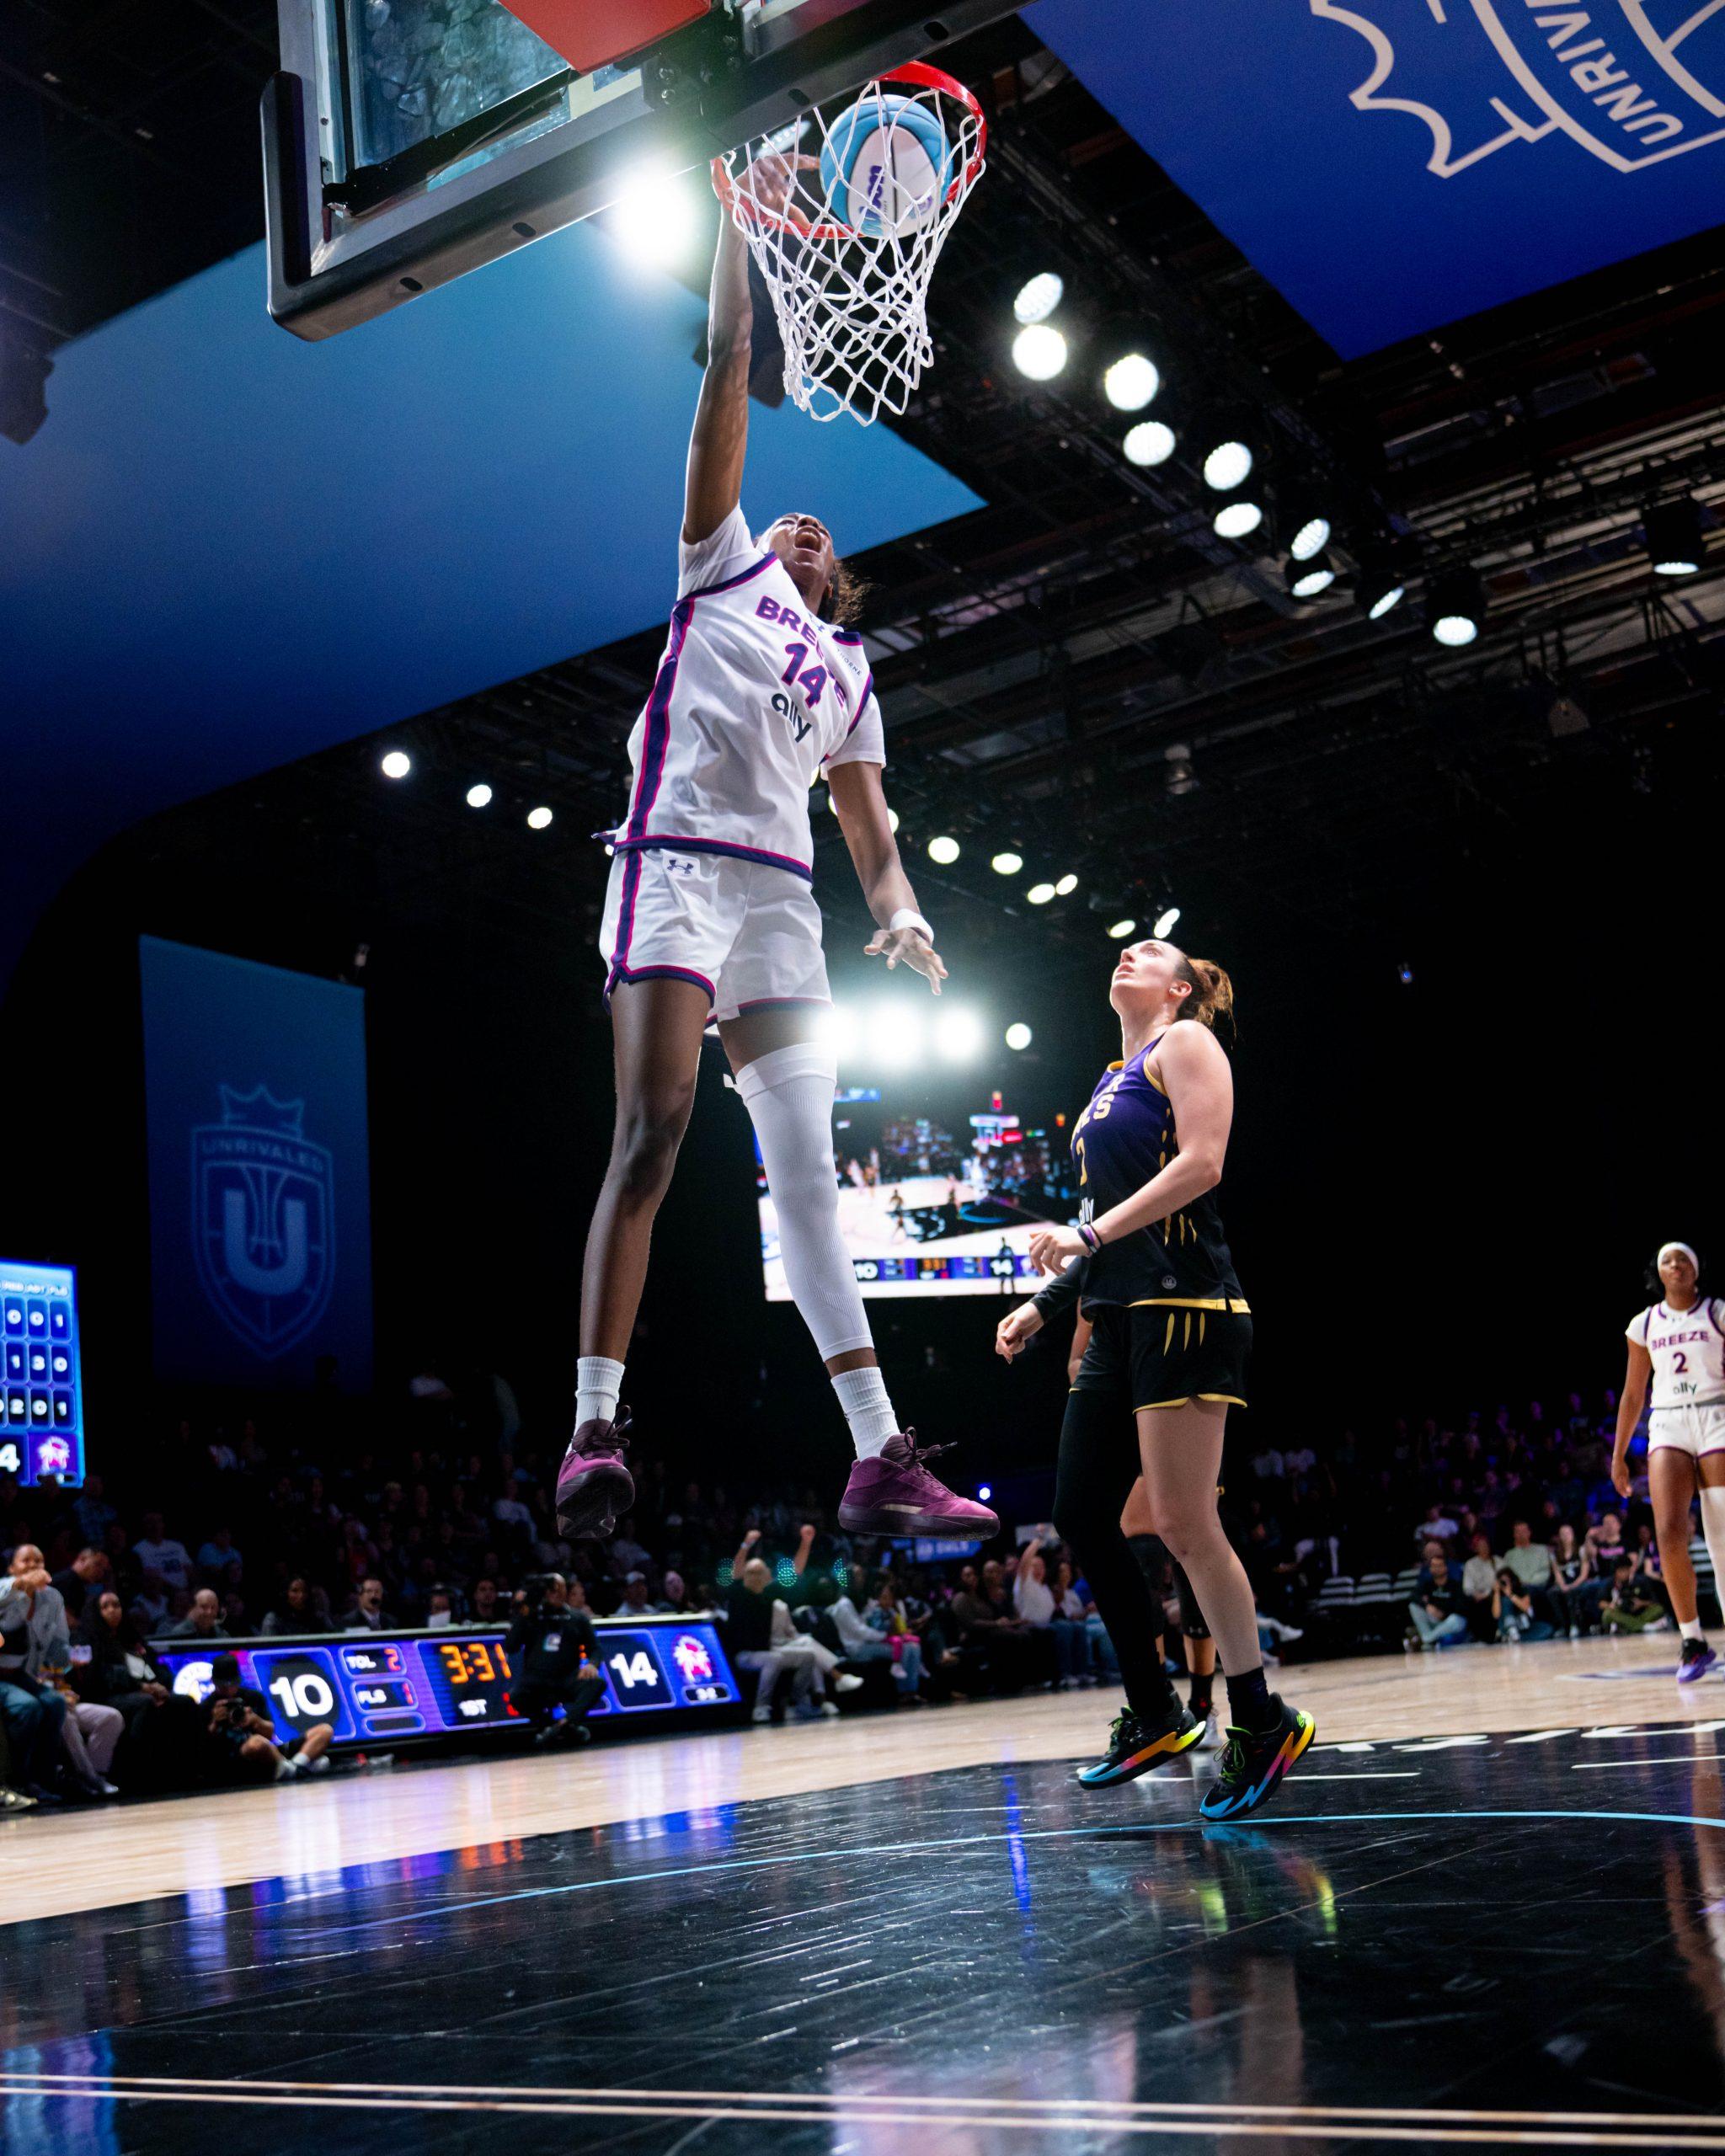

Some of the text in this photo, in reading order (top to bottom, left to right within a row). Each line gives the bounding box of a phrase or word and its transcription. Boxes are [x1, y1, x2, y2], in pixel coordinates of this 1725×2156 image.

[1525, 0, 1684, 145] UNRIV
[781, 641, 829, 710] 14
[771, 692, 813, 743] ally
[7, 1309, 22, 1325] 0
[29, 1310, 45, 1326] 0
[1652, 1330, 1710, 1351] BREEZE
[53, 1356, 68, 1373] 0
[1673, 1351, 1689, 1374] 2
[1673, 1381, 1697, 1396] ally
[32, 1399, 47, 1416] 0
[383, 1647, 402, 1672] 2
[440, 1642, 512, 1684] 3:31
[609, 1651, 659, 1689] 14
[268, 1673, 334, 1718] 10
[402, 1682, 414, 1705] 1
